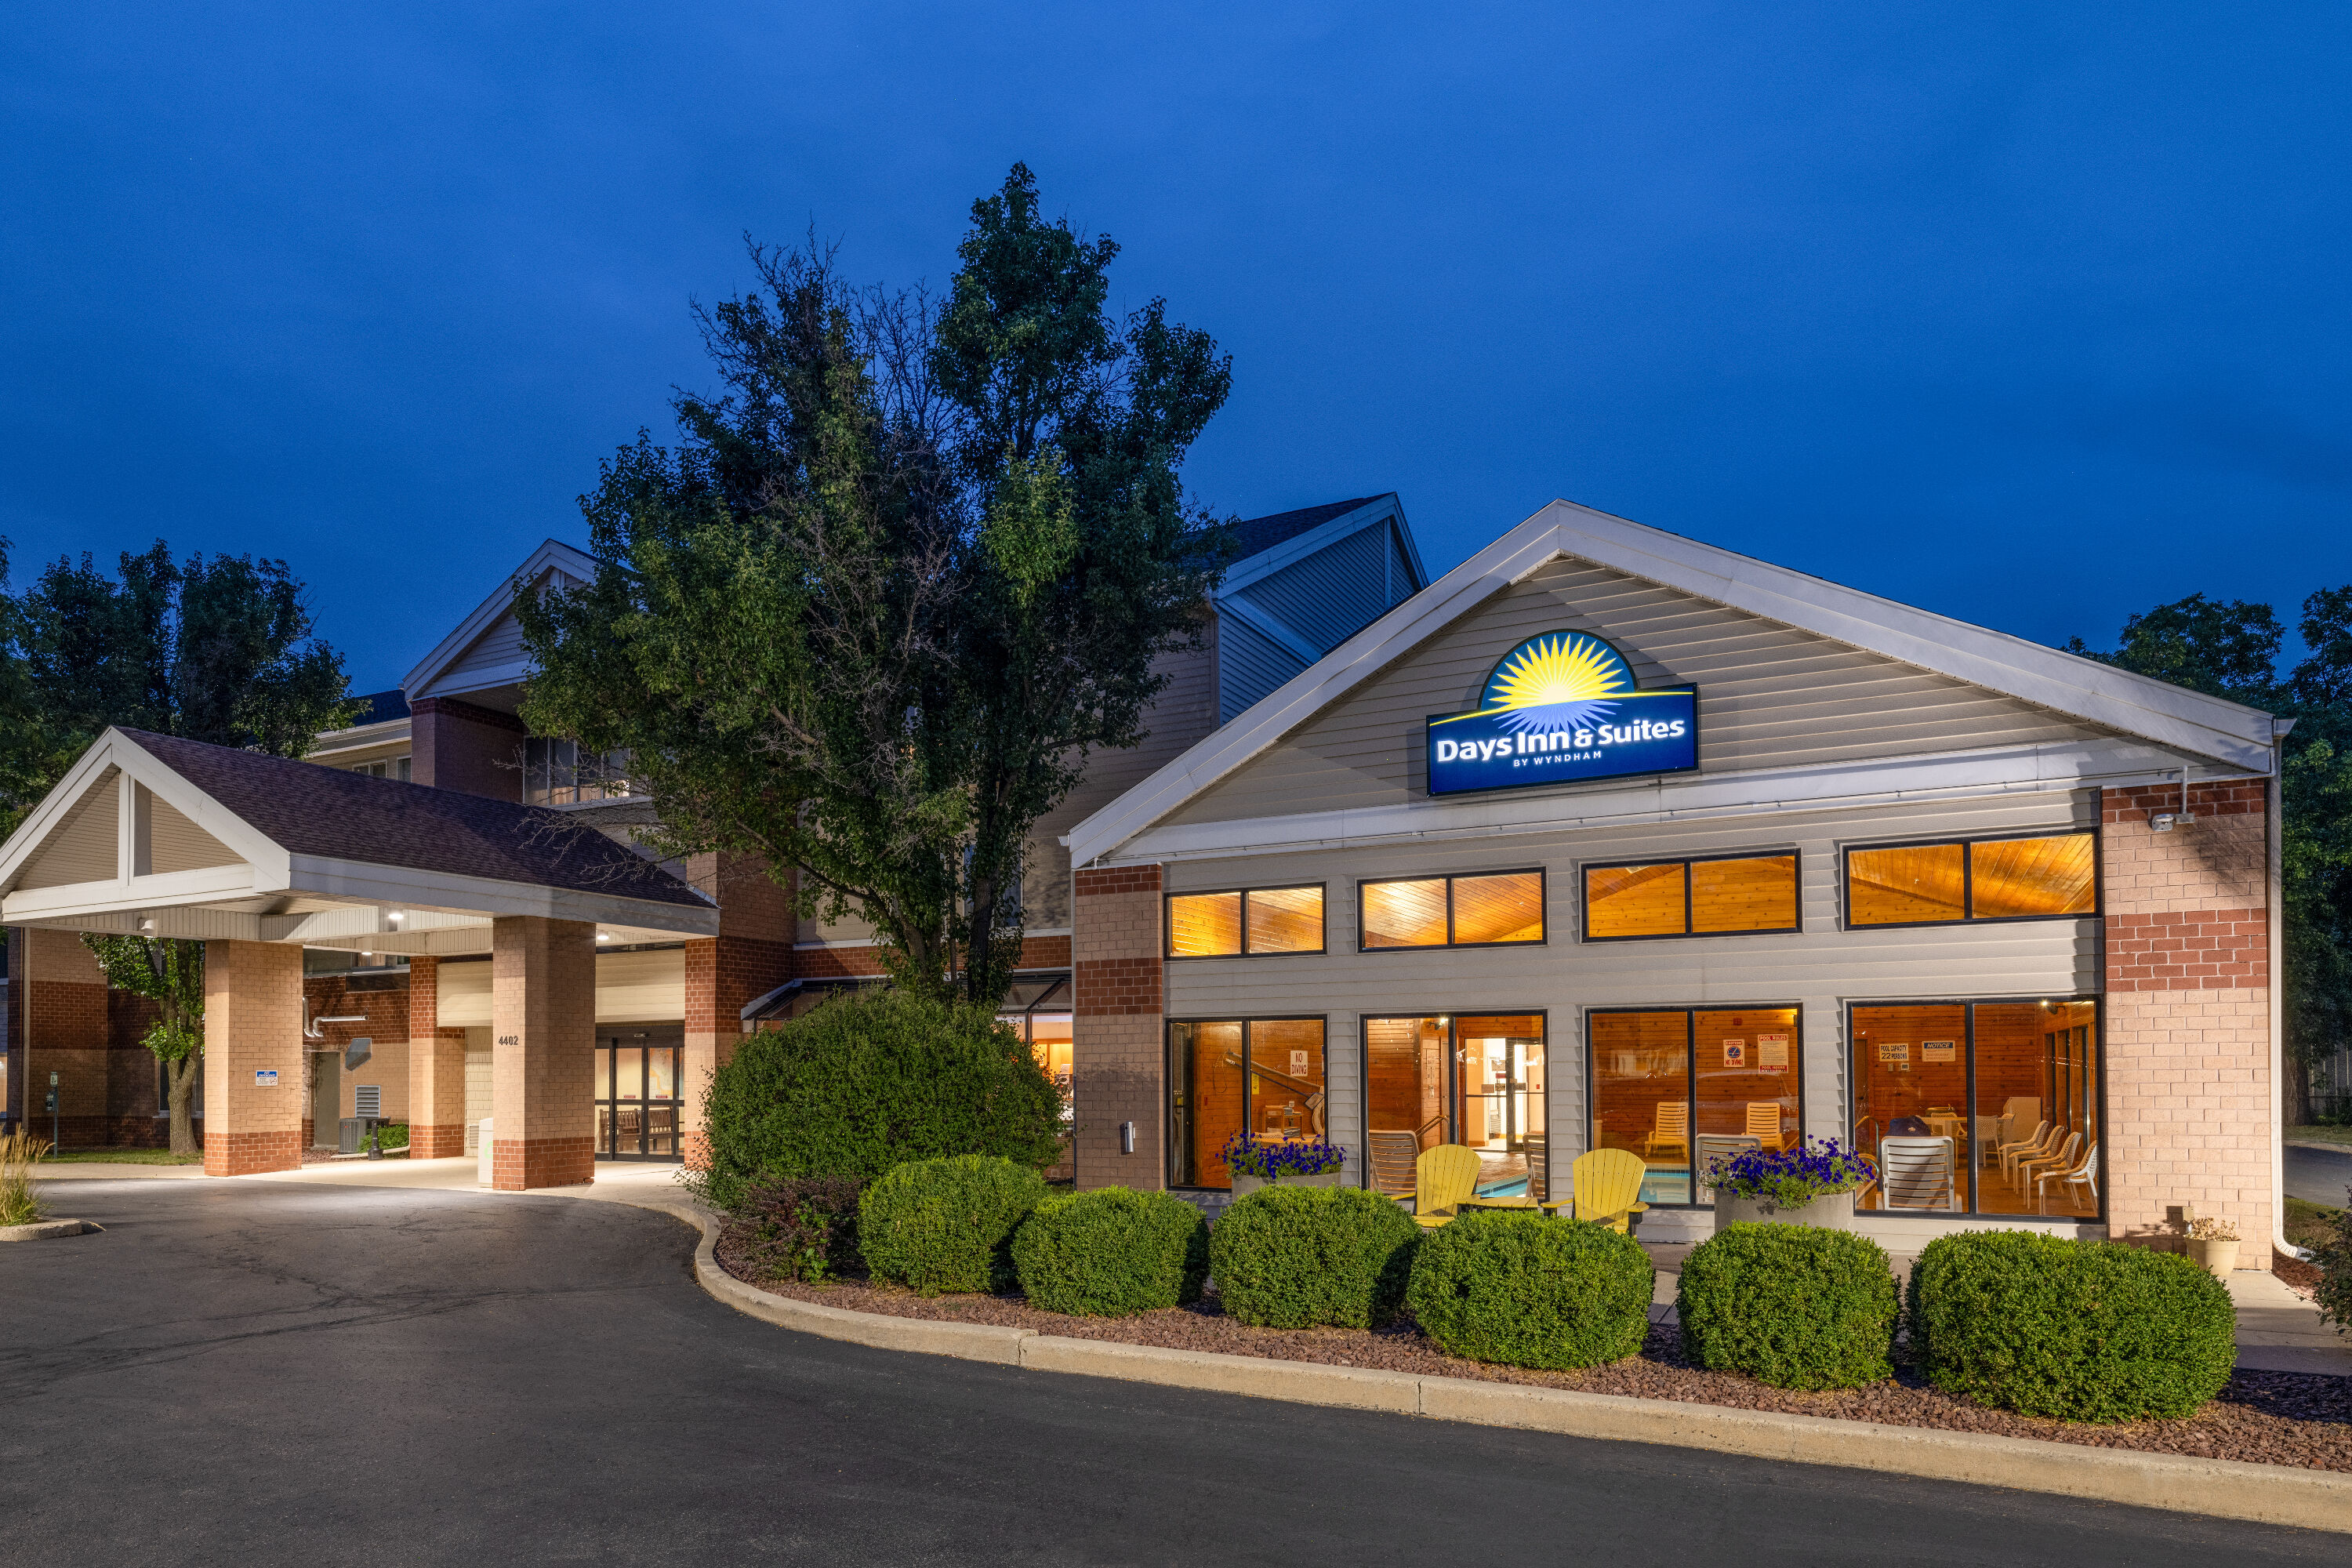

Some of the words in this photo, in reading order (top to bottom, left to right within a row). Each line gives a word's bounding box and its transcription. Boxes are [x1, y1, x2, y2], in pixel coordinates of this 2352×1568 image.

[1437, 736, 1512, 762] Days
[1518, 730, 1569, 754] Inn
[1574, 728, 1594, 747] &
[1599, 720, 1685, 746] Suites
[1513, 758, 1527, 768] BY
[1534, 750, 1602, 765] WYNDHAM
[499, 1036, 519, 1046] 4402
[1295, 1052, 1302, 1062] NO
[1291, 1064, 1307, 1074] DIVING
